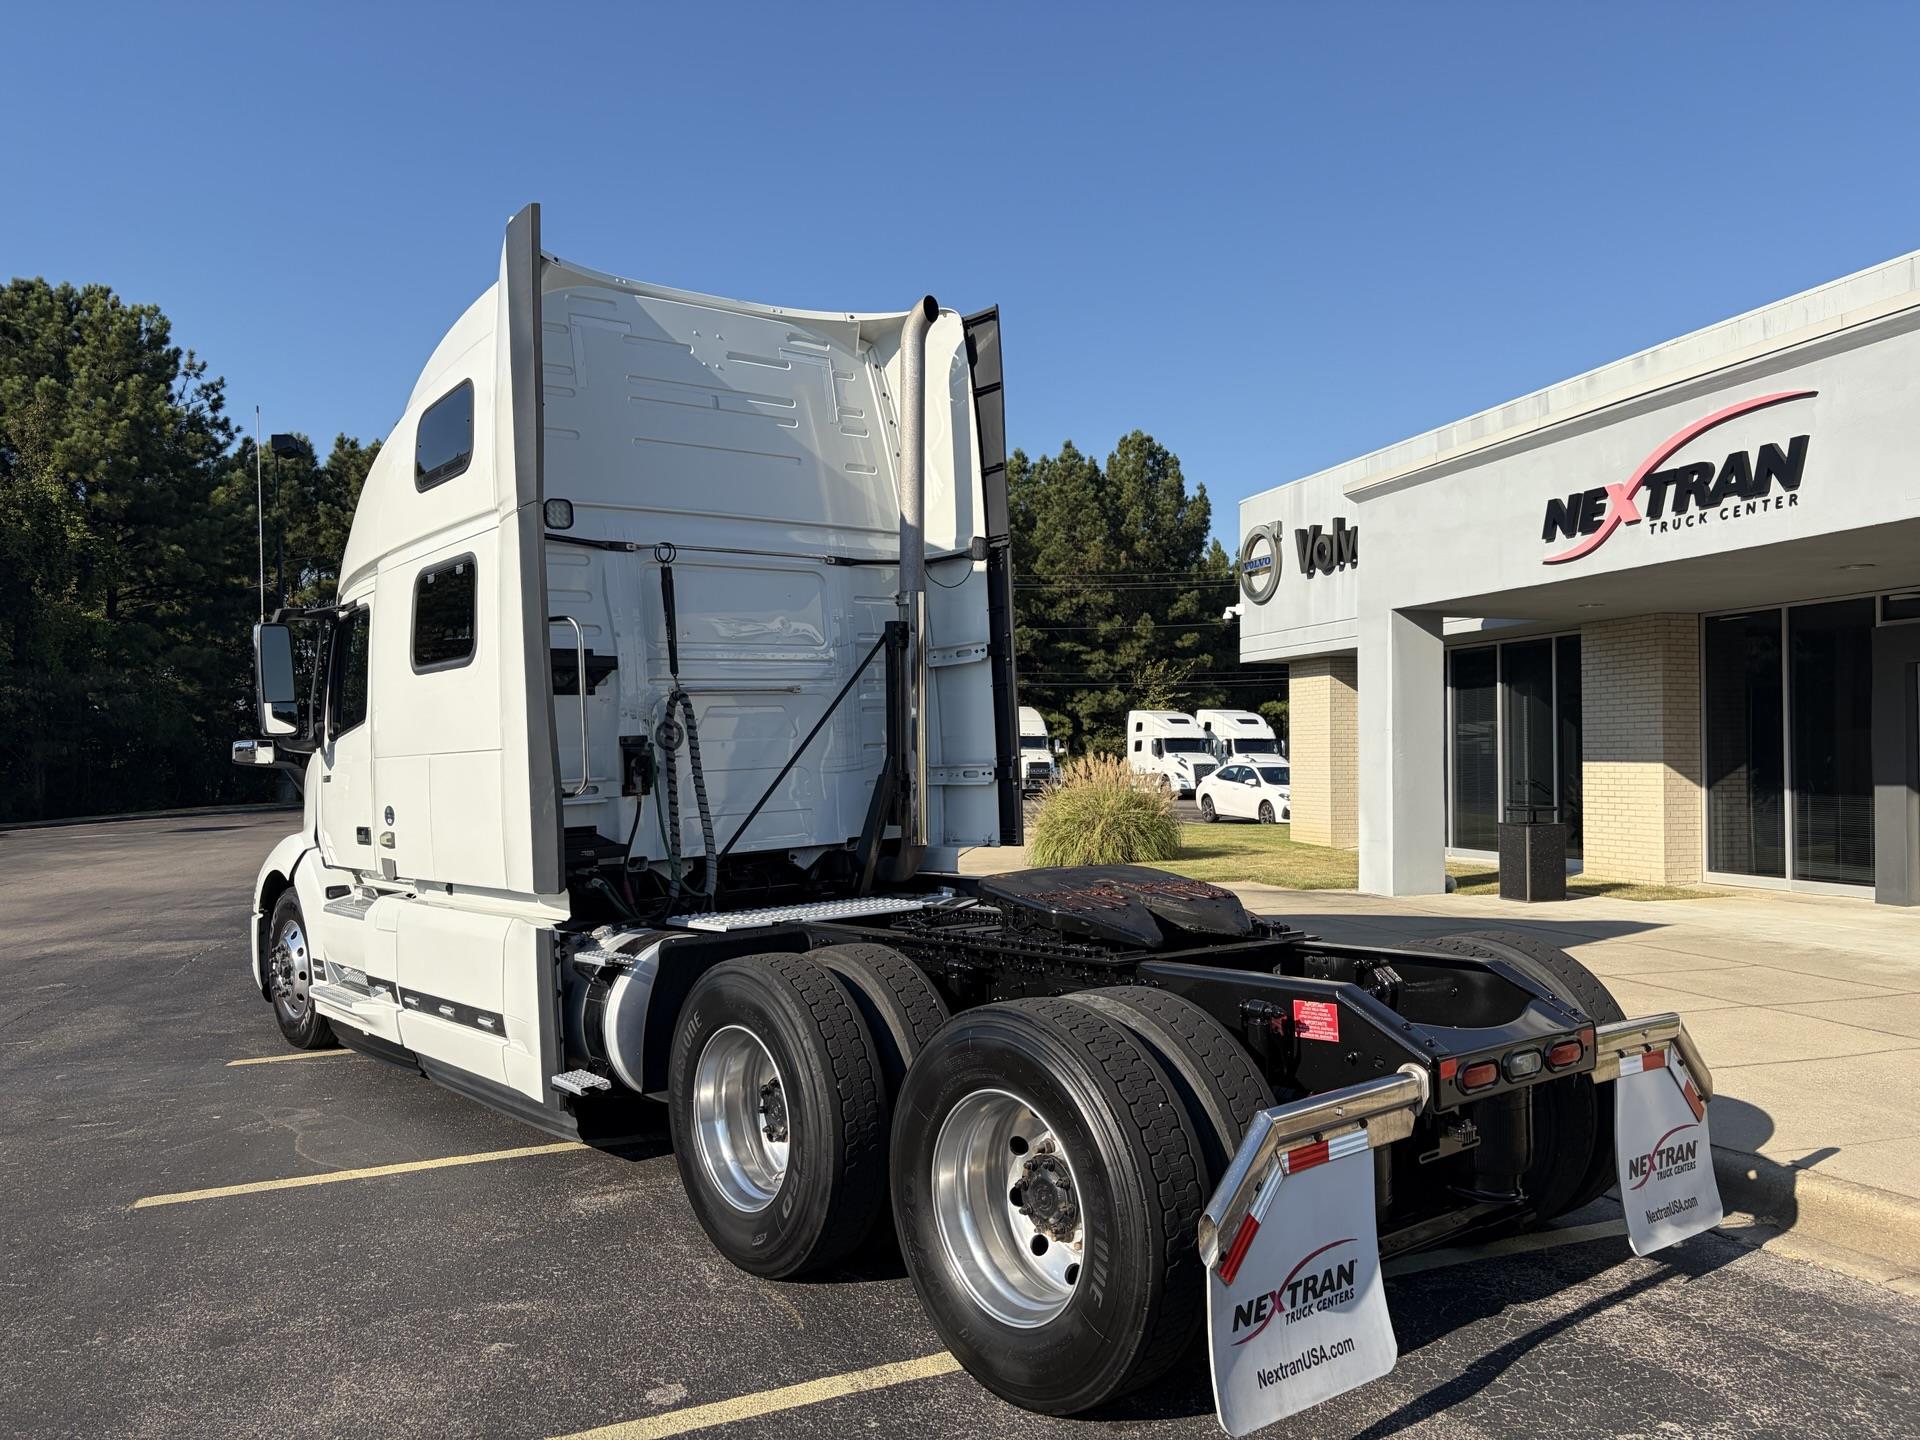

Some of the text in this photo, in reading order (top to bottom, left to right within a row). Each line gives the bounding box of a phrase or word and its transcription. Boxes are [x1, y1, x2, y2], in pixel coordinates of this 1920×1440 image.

[1541, 434, 1811, 544] NEXTRAN
[1650, 494, 1800, 535] TRUCK CENTER
[1243, 556, 1271, 572] VOLVO
[1295, 517, 1359, 578] Volv
[1629, 1140, 1698, 1180] NEXTRAN
[1657, 1161, 1697, 1181] TRUCK CENTERS
[1646, 1196, 1699, 1224] NextranUSA.com
[1232, 1260, 1356, 1332] NEXTRAN
[1285, 1287, 1355, 1326] TRUCK CENTERS
[1257, 1337, 1355, 1389] NextranUSA.com
